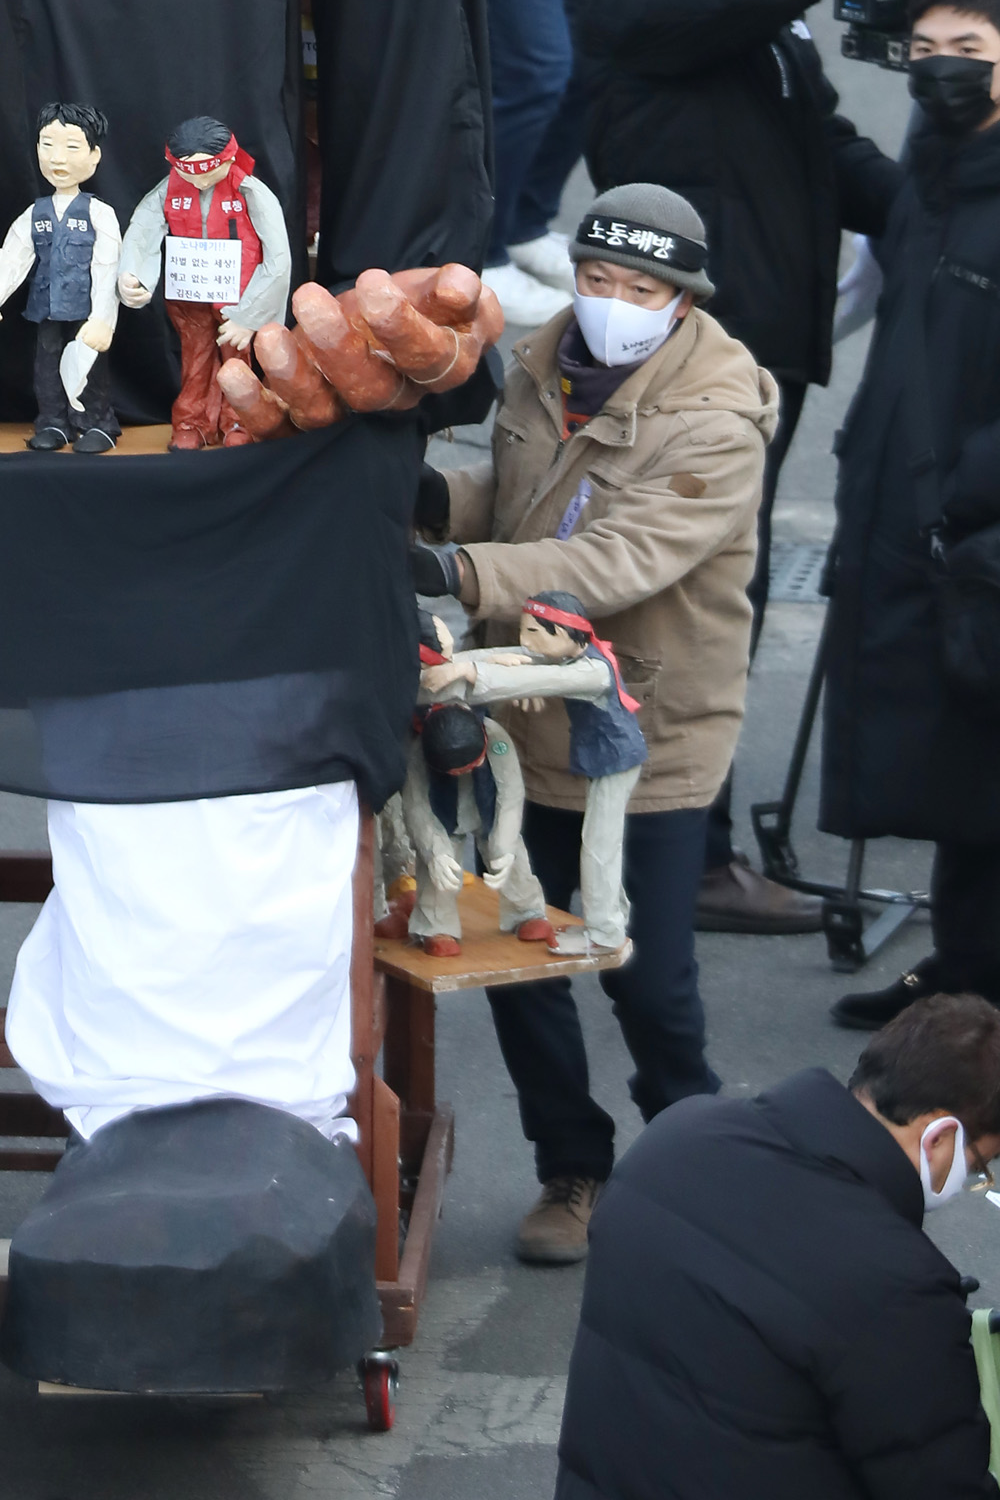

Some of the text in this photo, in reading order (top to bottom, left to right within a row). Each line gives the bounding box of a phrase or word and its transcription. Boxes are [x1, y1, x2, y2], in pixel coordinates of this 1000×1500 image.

[171, 197, 243, 214] 단결 투쟁
[34, 218, 88, 233] 단결 투쟁
[180, 240, 226, 252] 노나메기!!
[587, 220, 675, 260] 노동해방
[170, 256, 236, 269] 차별 없는 세상!
[191, 274, 209, 285] 없는
[214, 275, 236, 285] 세상!
[176, 288, 229, 301] 김진숙 복직!
